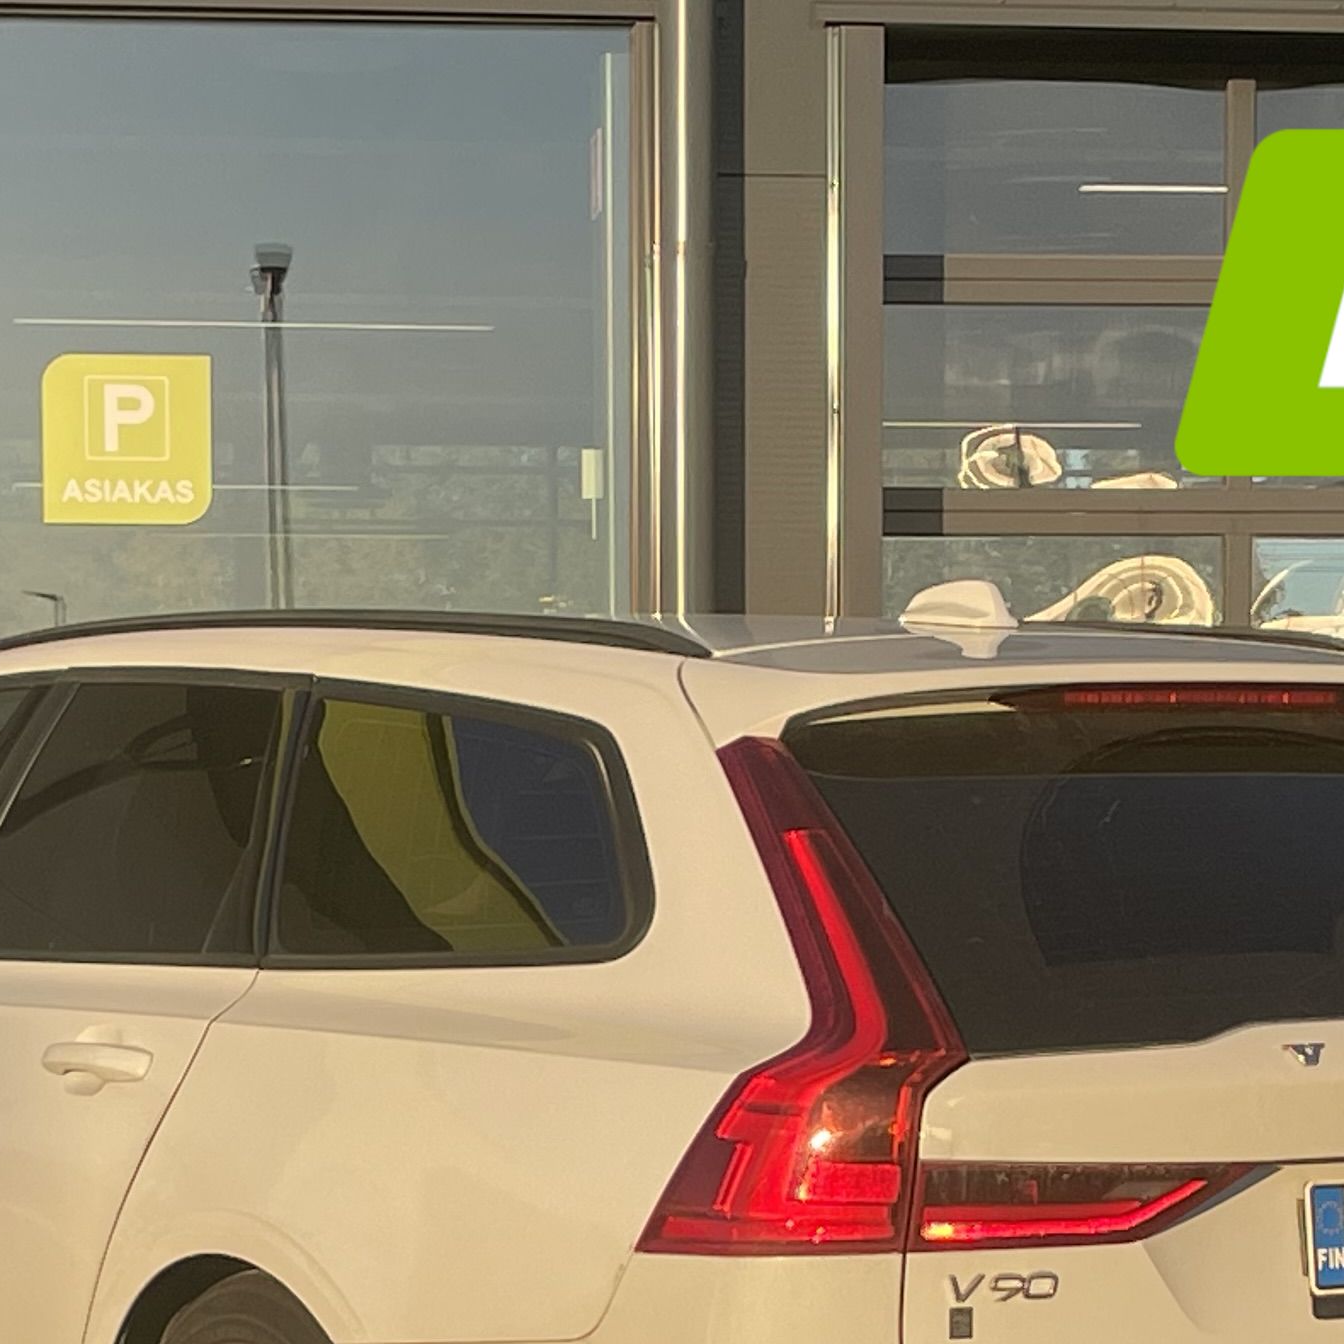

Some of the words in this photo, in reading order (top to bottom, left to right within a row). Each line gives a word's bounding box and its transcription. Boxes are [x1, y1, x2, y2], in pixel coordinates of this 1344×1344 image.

[103, 383, 155, 452] P
[62, 478, 195, 504] ASIAKAS
[948, 1270, 1059, 1303] V90
